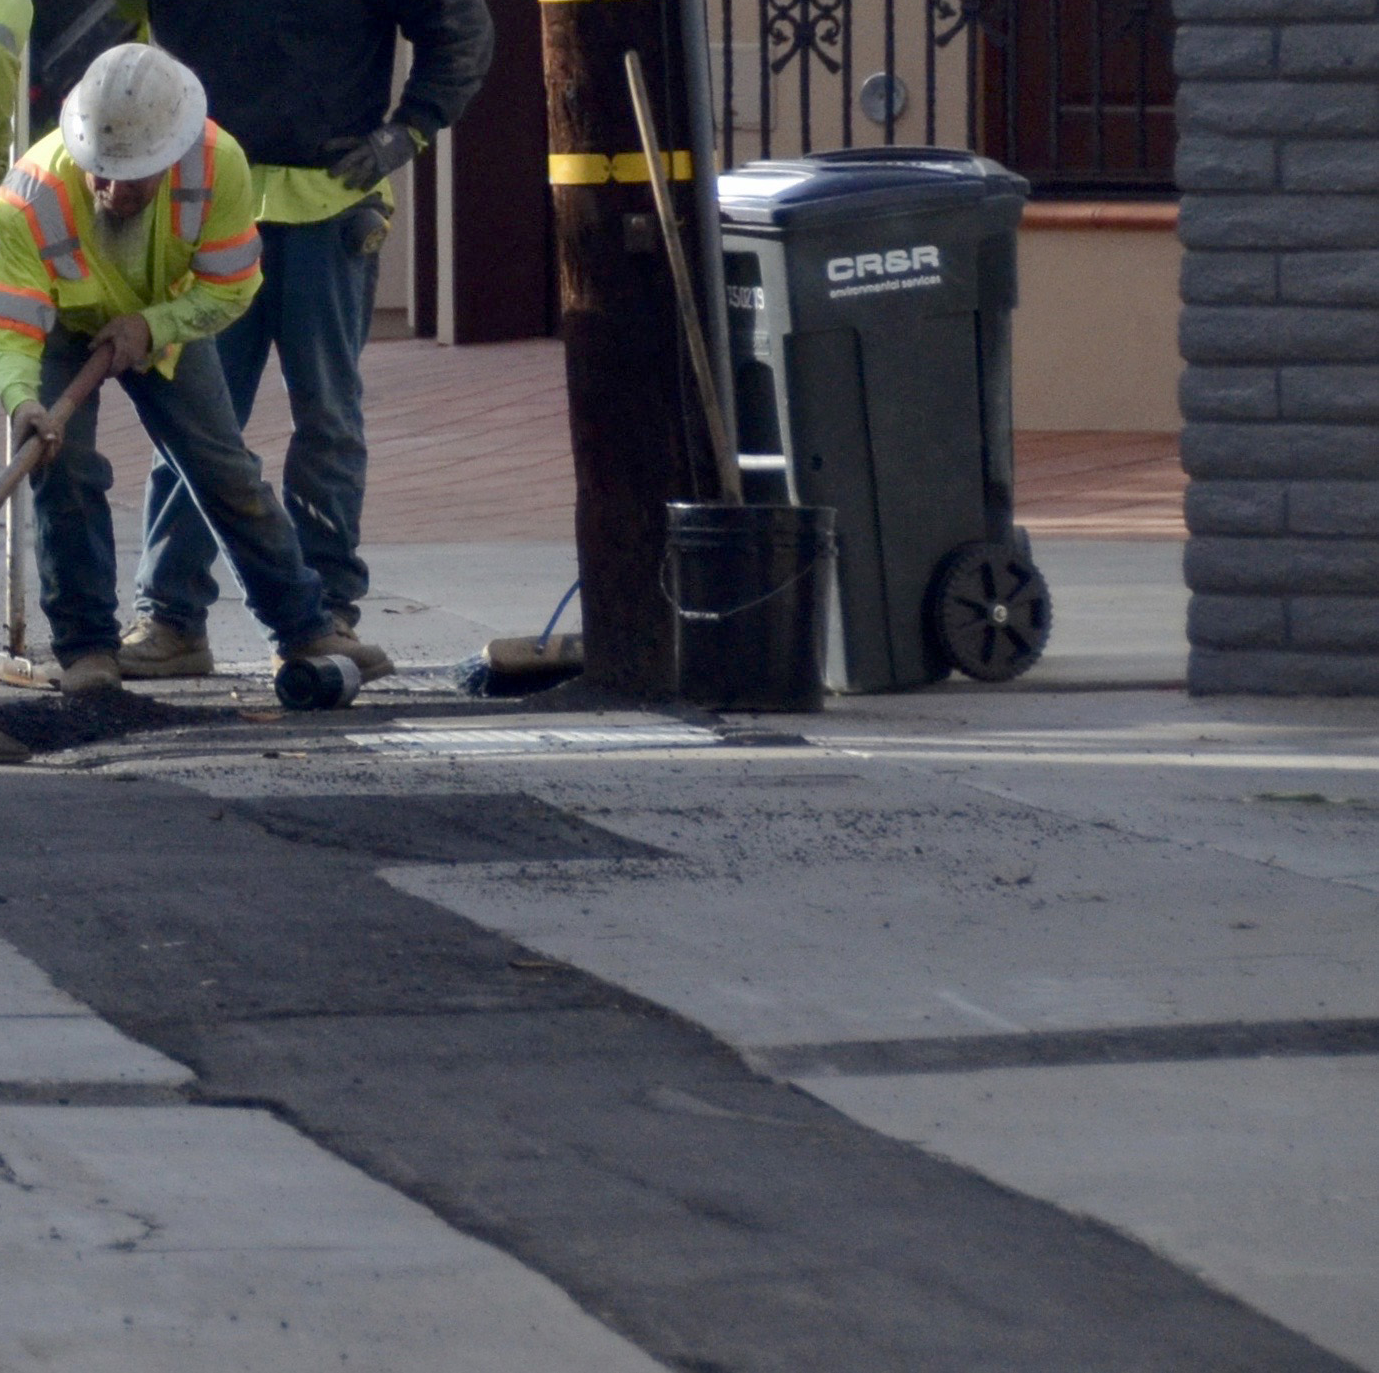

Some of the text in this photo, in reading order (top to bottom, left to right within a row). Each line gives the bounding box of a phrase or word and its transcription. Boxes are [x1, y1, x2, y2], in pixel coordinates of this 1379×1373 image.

[826, 244, 941, 282] CR&R
[829, 275, 941, 300] environmental services
